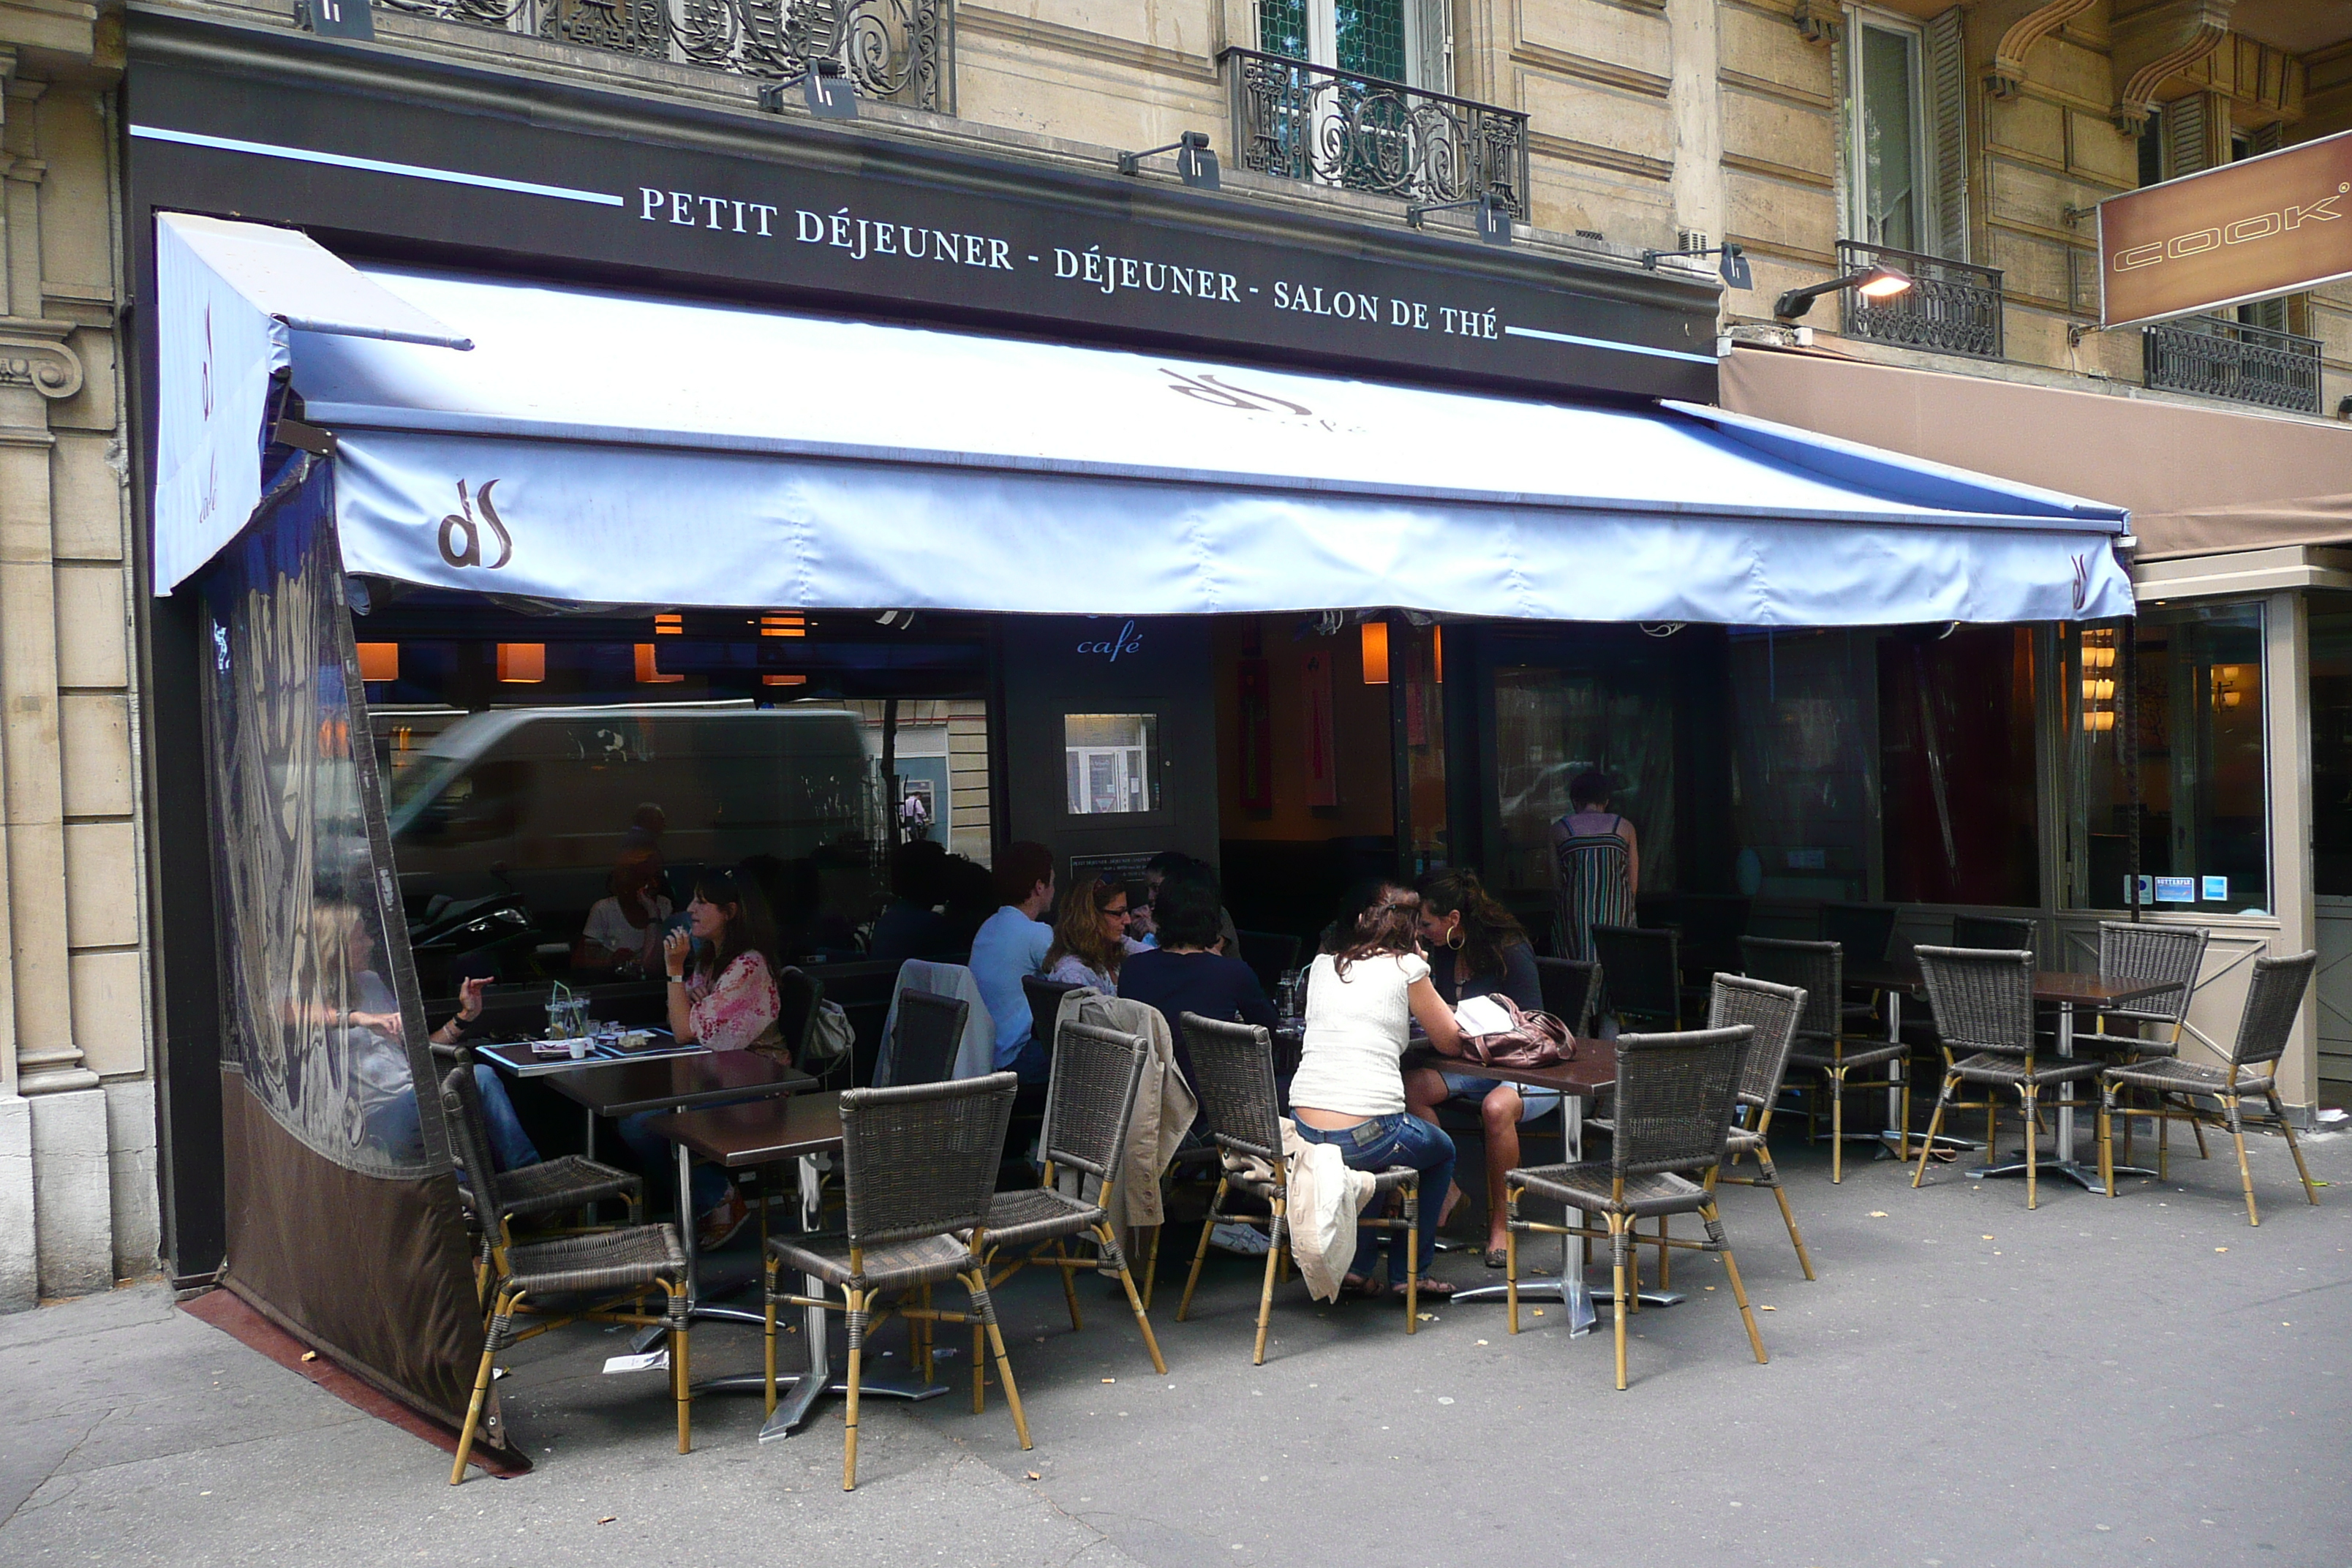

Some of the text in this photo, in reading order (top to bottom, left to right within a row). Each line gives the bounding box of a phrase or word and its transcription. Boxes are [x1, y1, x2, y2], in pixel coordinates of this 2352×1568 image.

[638, 186, 778, 237] PETIT
[795, 207, 1014, 271] DÉJEUNER
[1053, 244, 1241, 303] DÉJEUNER
[1274, 281, 1379, 323] SALON
[1390, 299, 1429, 330] DE
[1439, 306, 1498, 341] THÉ
[2114, 195, 2342, 272] COOK
[1077, 619, 1143, 663] café
